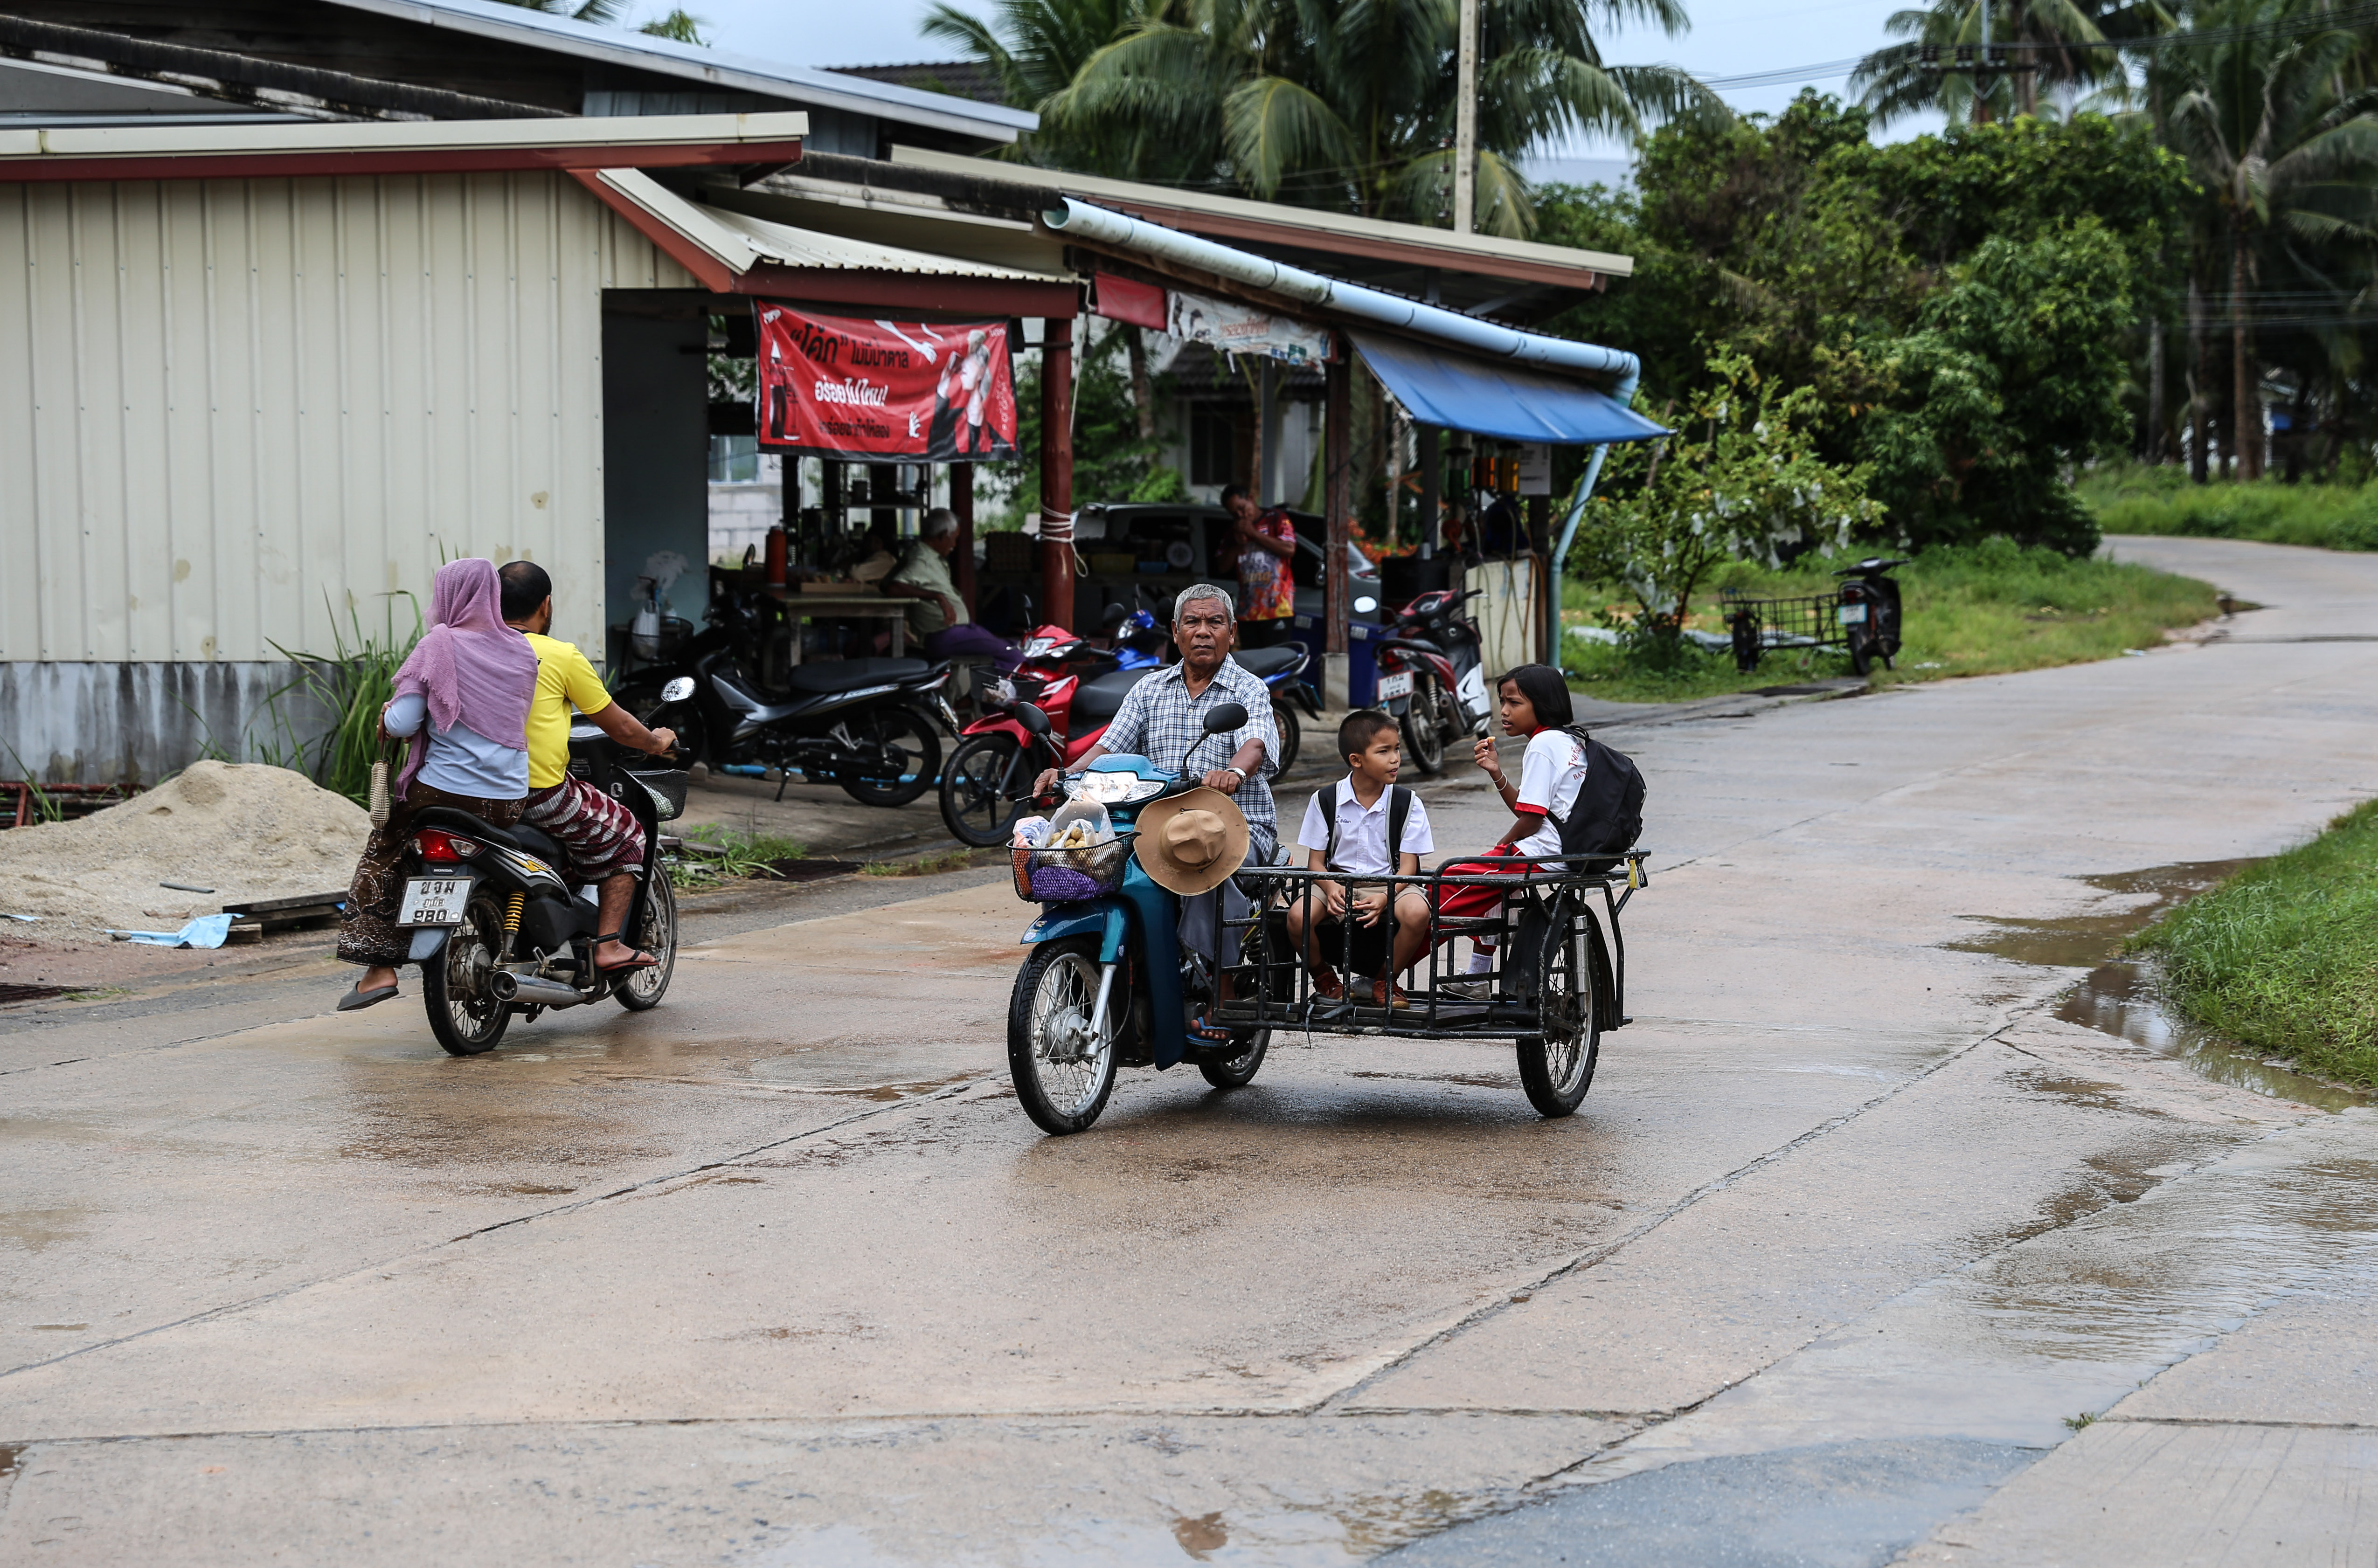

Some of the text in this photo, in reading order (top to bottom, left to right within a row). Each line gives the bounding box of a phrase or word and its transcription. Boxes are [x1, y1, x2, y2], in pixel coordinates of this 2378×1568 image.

[814, 374, 889, 407] อร่อยไปไหน!
[413, 910, 448, 922] 980
